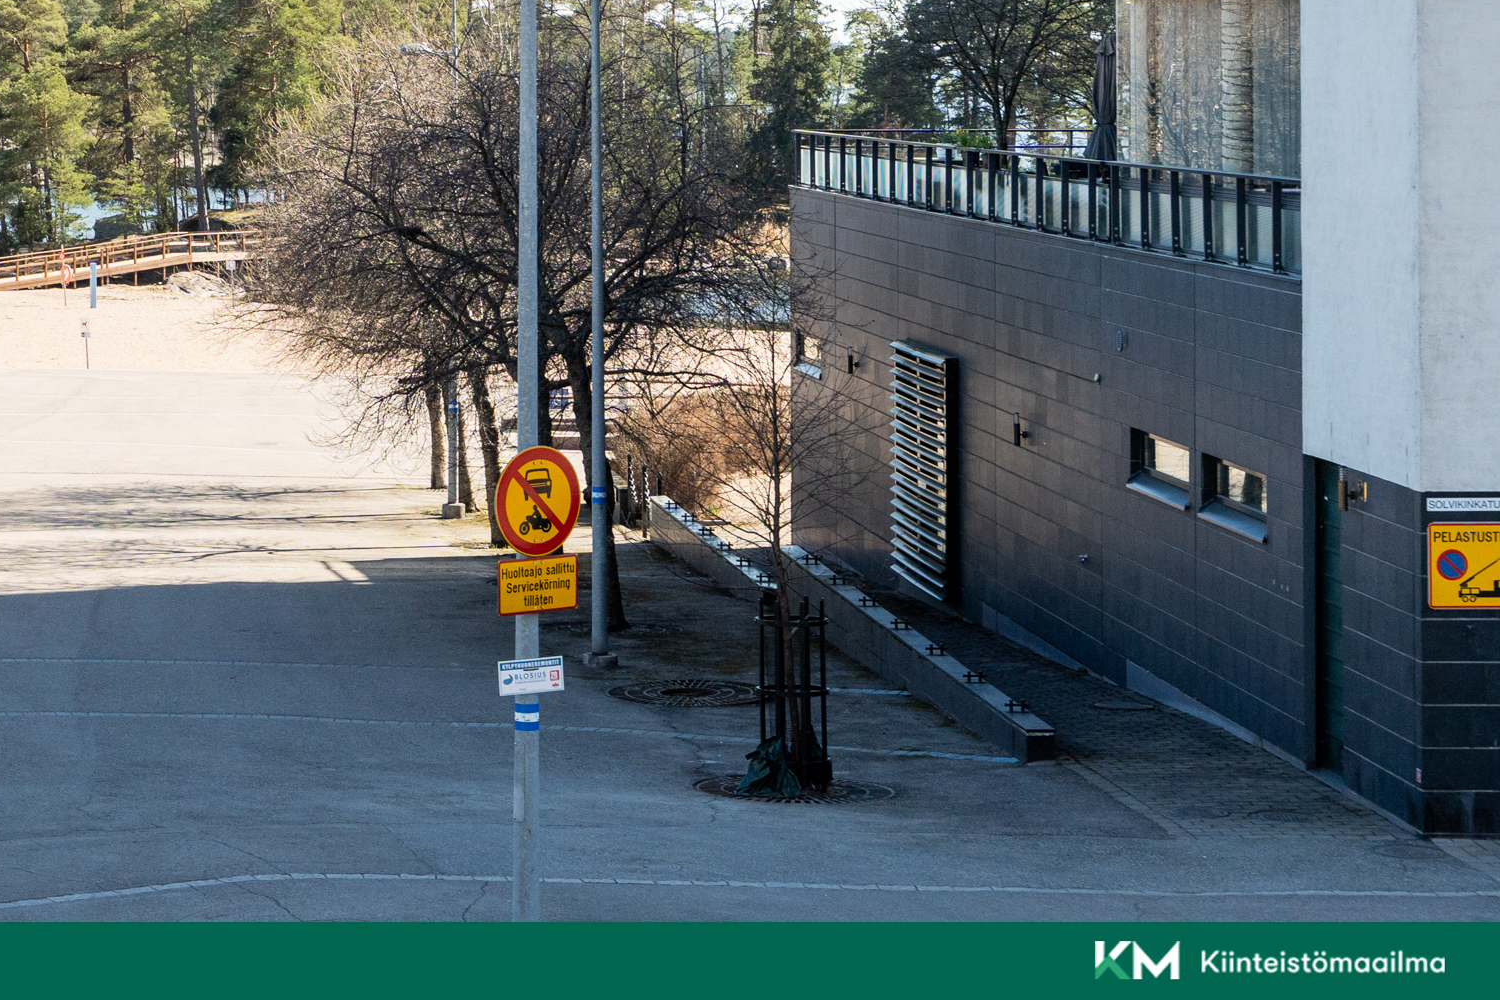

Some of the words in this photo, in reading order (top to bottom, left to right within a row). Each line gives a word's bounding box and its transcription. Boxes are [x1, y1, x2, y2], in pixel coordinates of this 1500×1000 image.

[1428, 500, 1500, 509] SOLVIKINKATU
[1433, 531, 1500, 543] PELASTUST
[501, 565, 543, 580] Huoltoajo
[545, 562, 575, 576] sallittu
[506, 578, 571, 594] Servicekörning
[524, 594, 554, 607] tillåten
[514, 671, 547, 680] BLOSIUS
